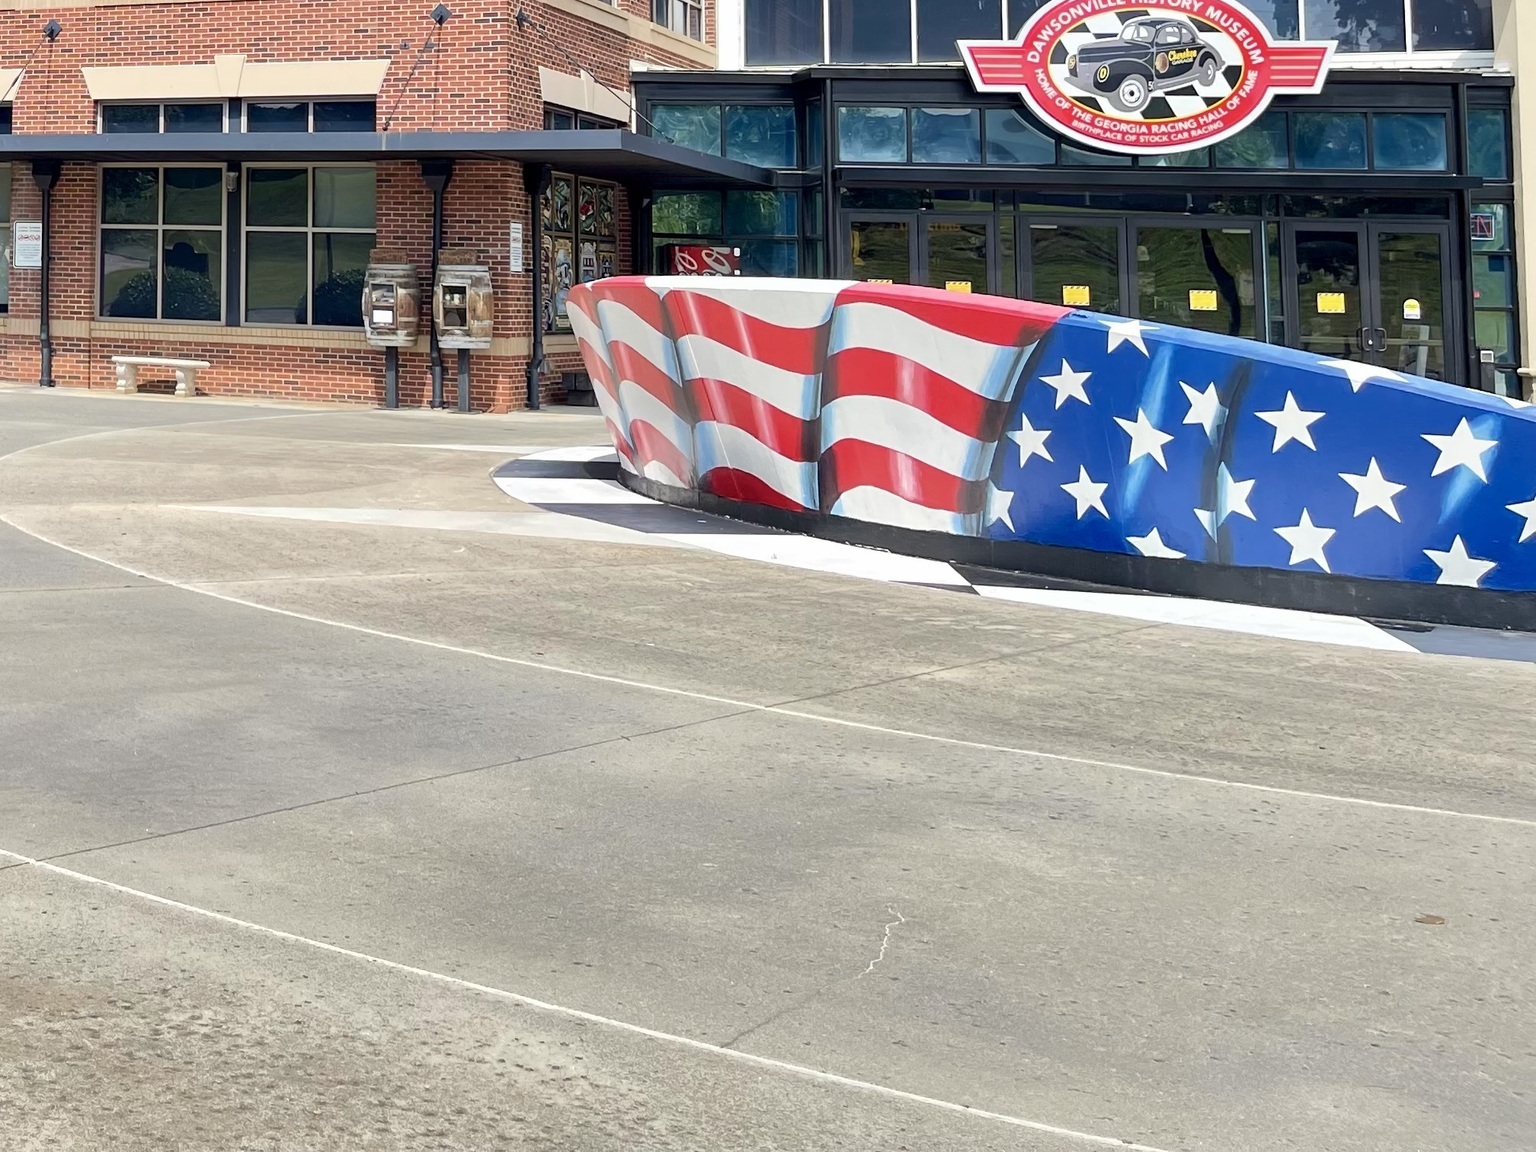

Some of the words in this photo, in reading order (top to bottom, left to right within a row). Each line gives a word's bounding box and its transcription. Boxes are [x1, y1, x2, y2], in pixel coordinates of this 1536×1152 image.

[1205, 5, 1264, 65] MUSEUM
[1034, 68, 1058, 100] HOME
[1055, 97, 1072, 110] OF
[1071, 106, 1093, 124] THE
[1094, 117, 1148, 134] GEORGIA
[1151, 120, 1197, 134] RACING
[1198, 107, 1228, 125] HALL
[1226, 96, 1242, 110] OF
[1238, 69, 1259, 98] FAME
[1071, 119, 1123, 141] BIRTHPLACE
[1125, 134, 1138, 142] OF
[1139, 133, 1169, 143] STOCK
[1170, 131, 1190, 141] CAR
[1190, 120, 1224, 138] RACING
